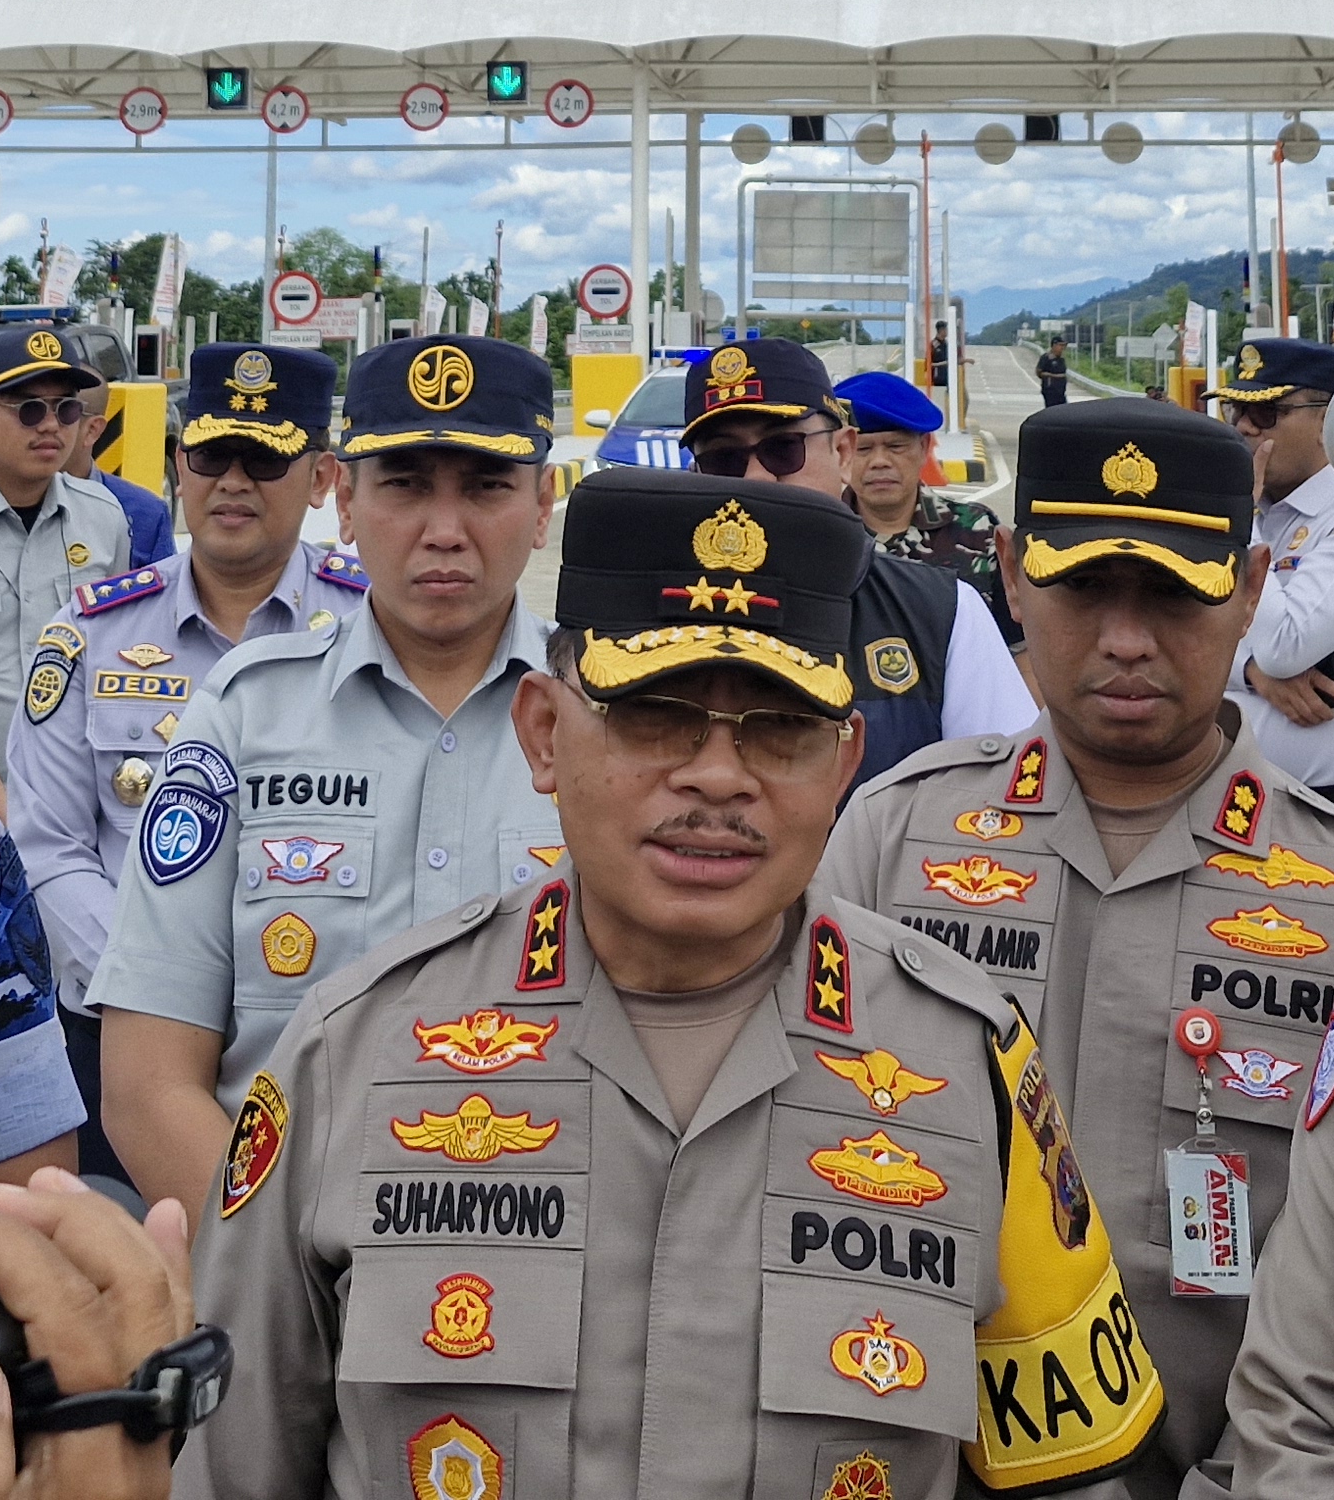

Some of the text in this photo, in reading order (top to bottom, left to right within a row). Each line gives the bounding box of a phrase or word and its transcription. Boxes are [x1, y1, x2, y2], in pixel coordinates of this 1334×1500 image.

[103, 676, 182, 695] DEDY
[171, 749, 229, 787] CABANG SUMBAR
[158, 791, 218, 824] JASA RAHARJA
[245, 773, 368, 810] TEGUH
[975, 925, 1040, 970] AMIR
[1191, 963, 1334, 1026] POLRI
[848, 1177, 910, 1198] PENYIDIK
[372, 1181, 565, 1239] SUHARYONO
[1210, 1169, 1232, 1266] AMAN
[791, 1211, 956, 1288] POLRI
[869, 1339, 891, 1352] SAR
[980, 1350, 1093, 1447] KA
